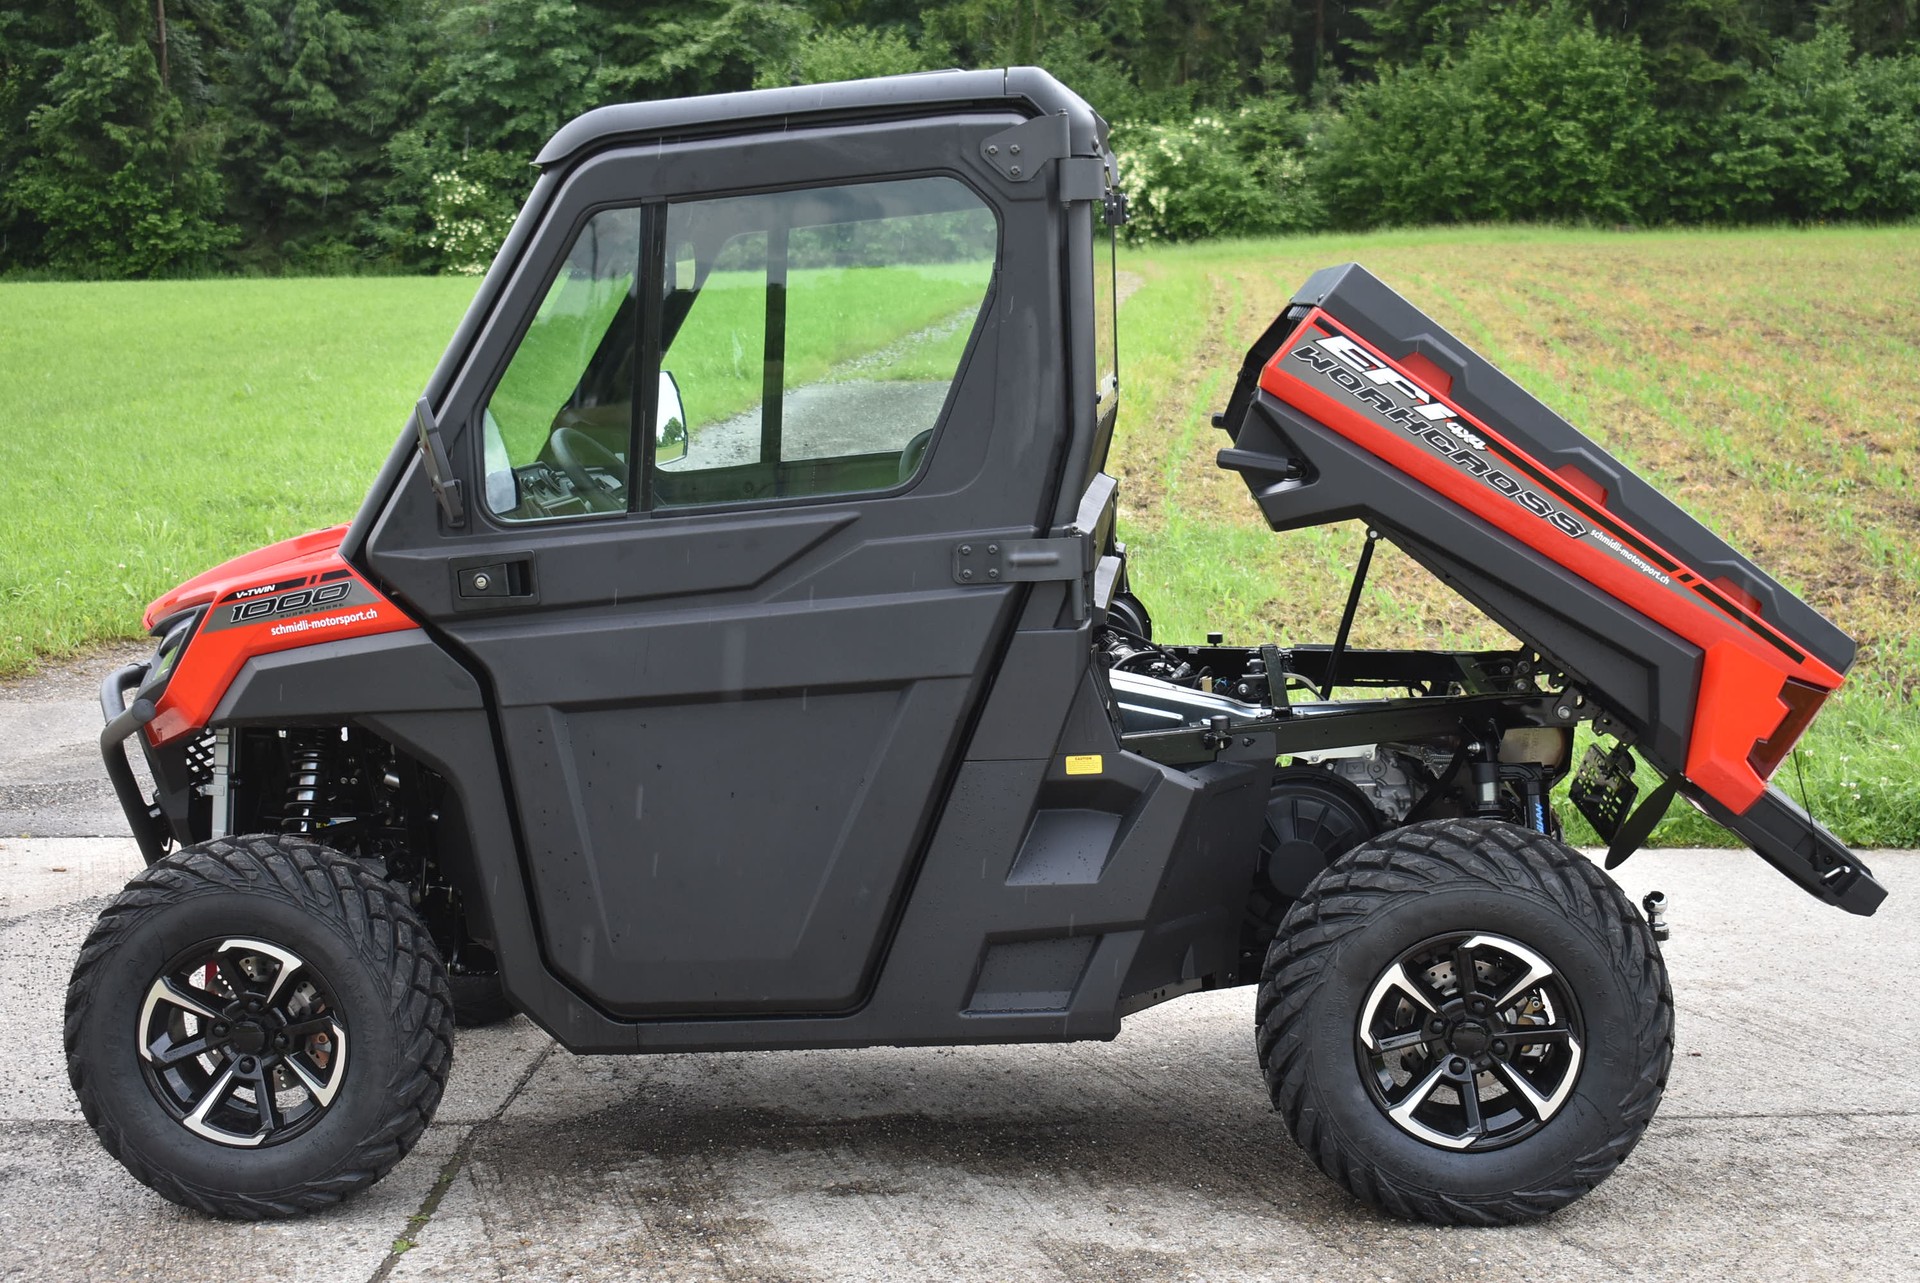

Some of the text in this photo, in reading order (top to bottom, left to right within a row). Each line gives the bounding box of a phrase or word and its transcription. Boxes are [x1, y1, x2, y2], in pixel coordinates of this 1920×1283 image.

[1313, 335, 1458, 421] EFI
[1291, 345, 1588, 539] WORKCROSS
[1590, 529, 1670, 585] schmidli-motorsport.ch
[230, 580, 352, 623] 1000
[236, 584, 276, 599] V-TWIN
[270, 608, 378, 636] schmidli-motorsport.ch
